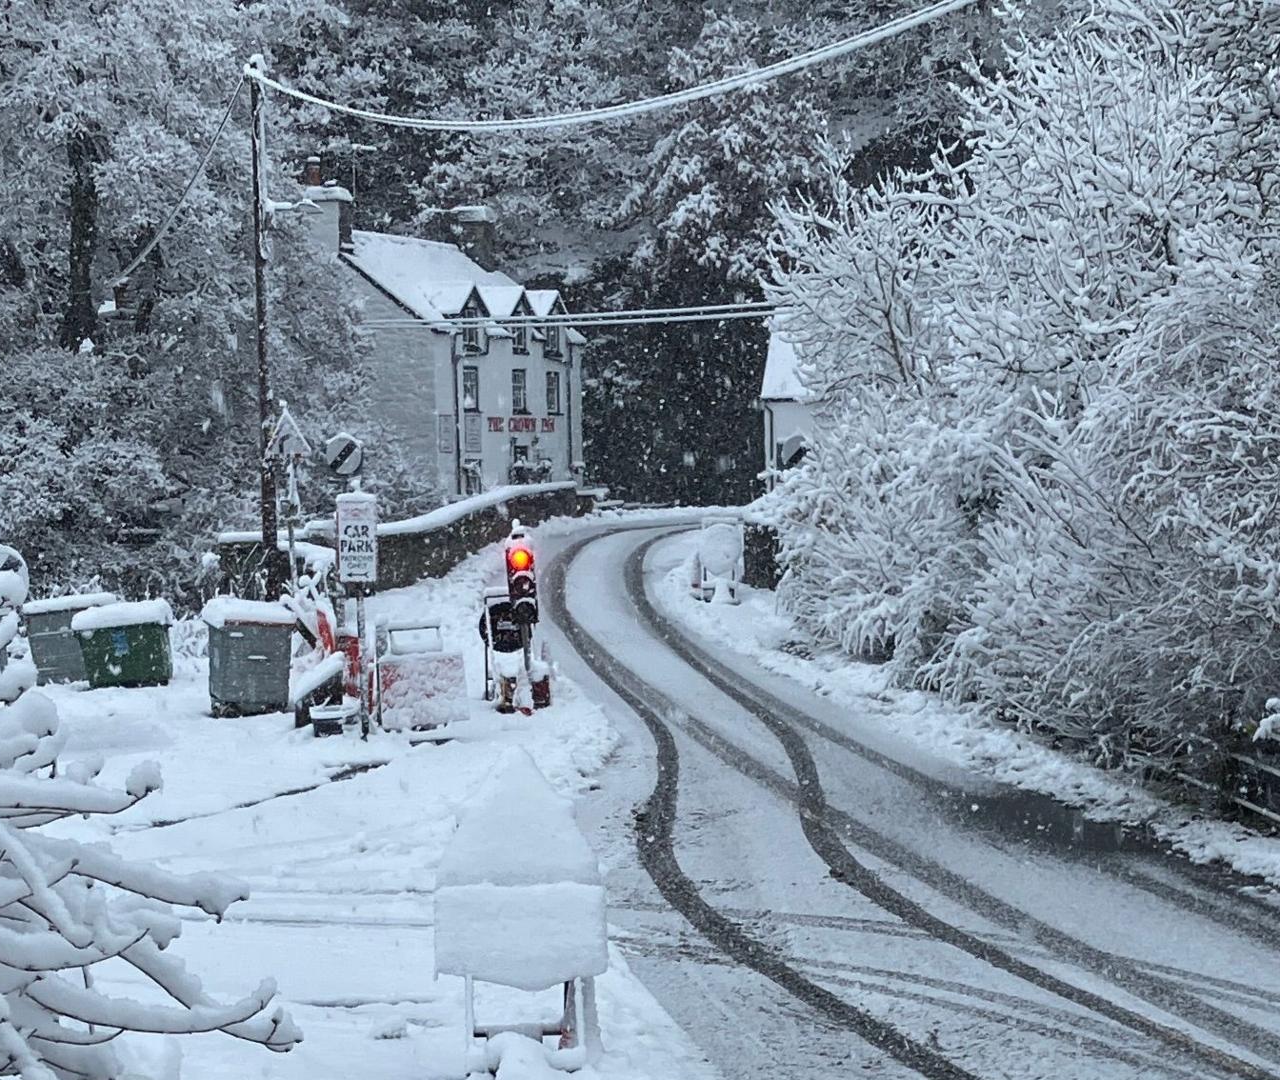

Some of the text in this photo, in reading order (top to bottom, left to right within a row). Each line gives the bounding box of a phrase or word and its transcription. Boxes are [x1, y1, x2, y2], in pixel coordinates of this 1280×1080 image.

[487, 417, 555, 433] THE CROWN INN
[344, 525, 369, 538] CAR
[340, 540, 374, 553] PARK
